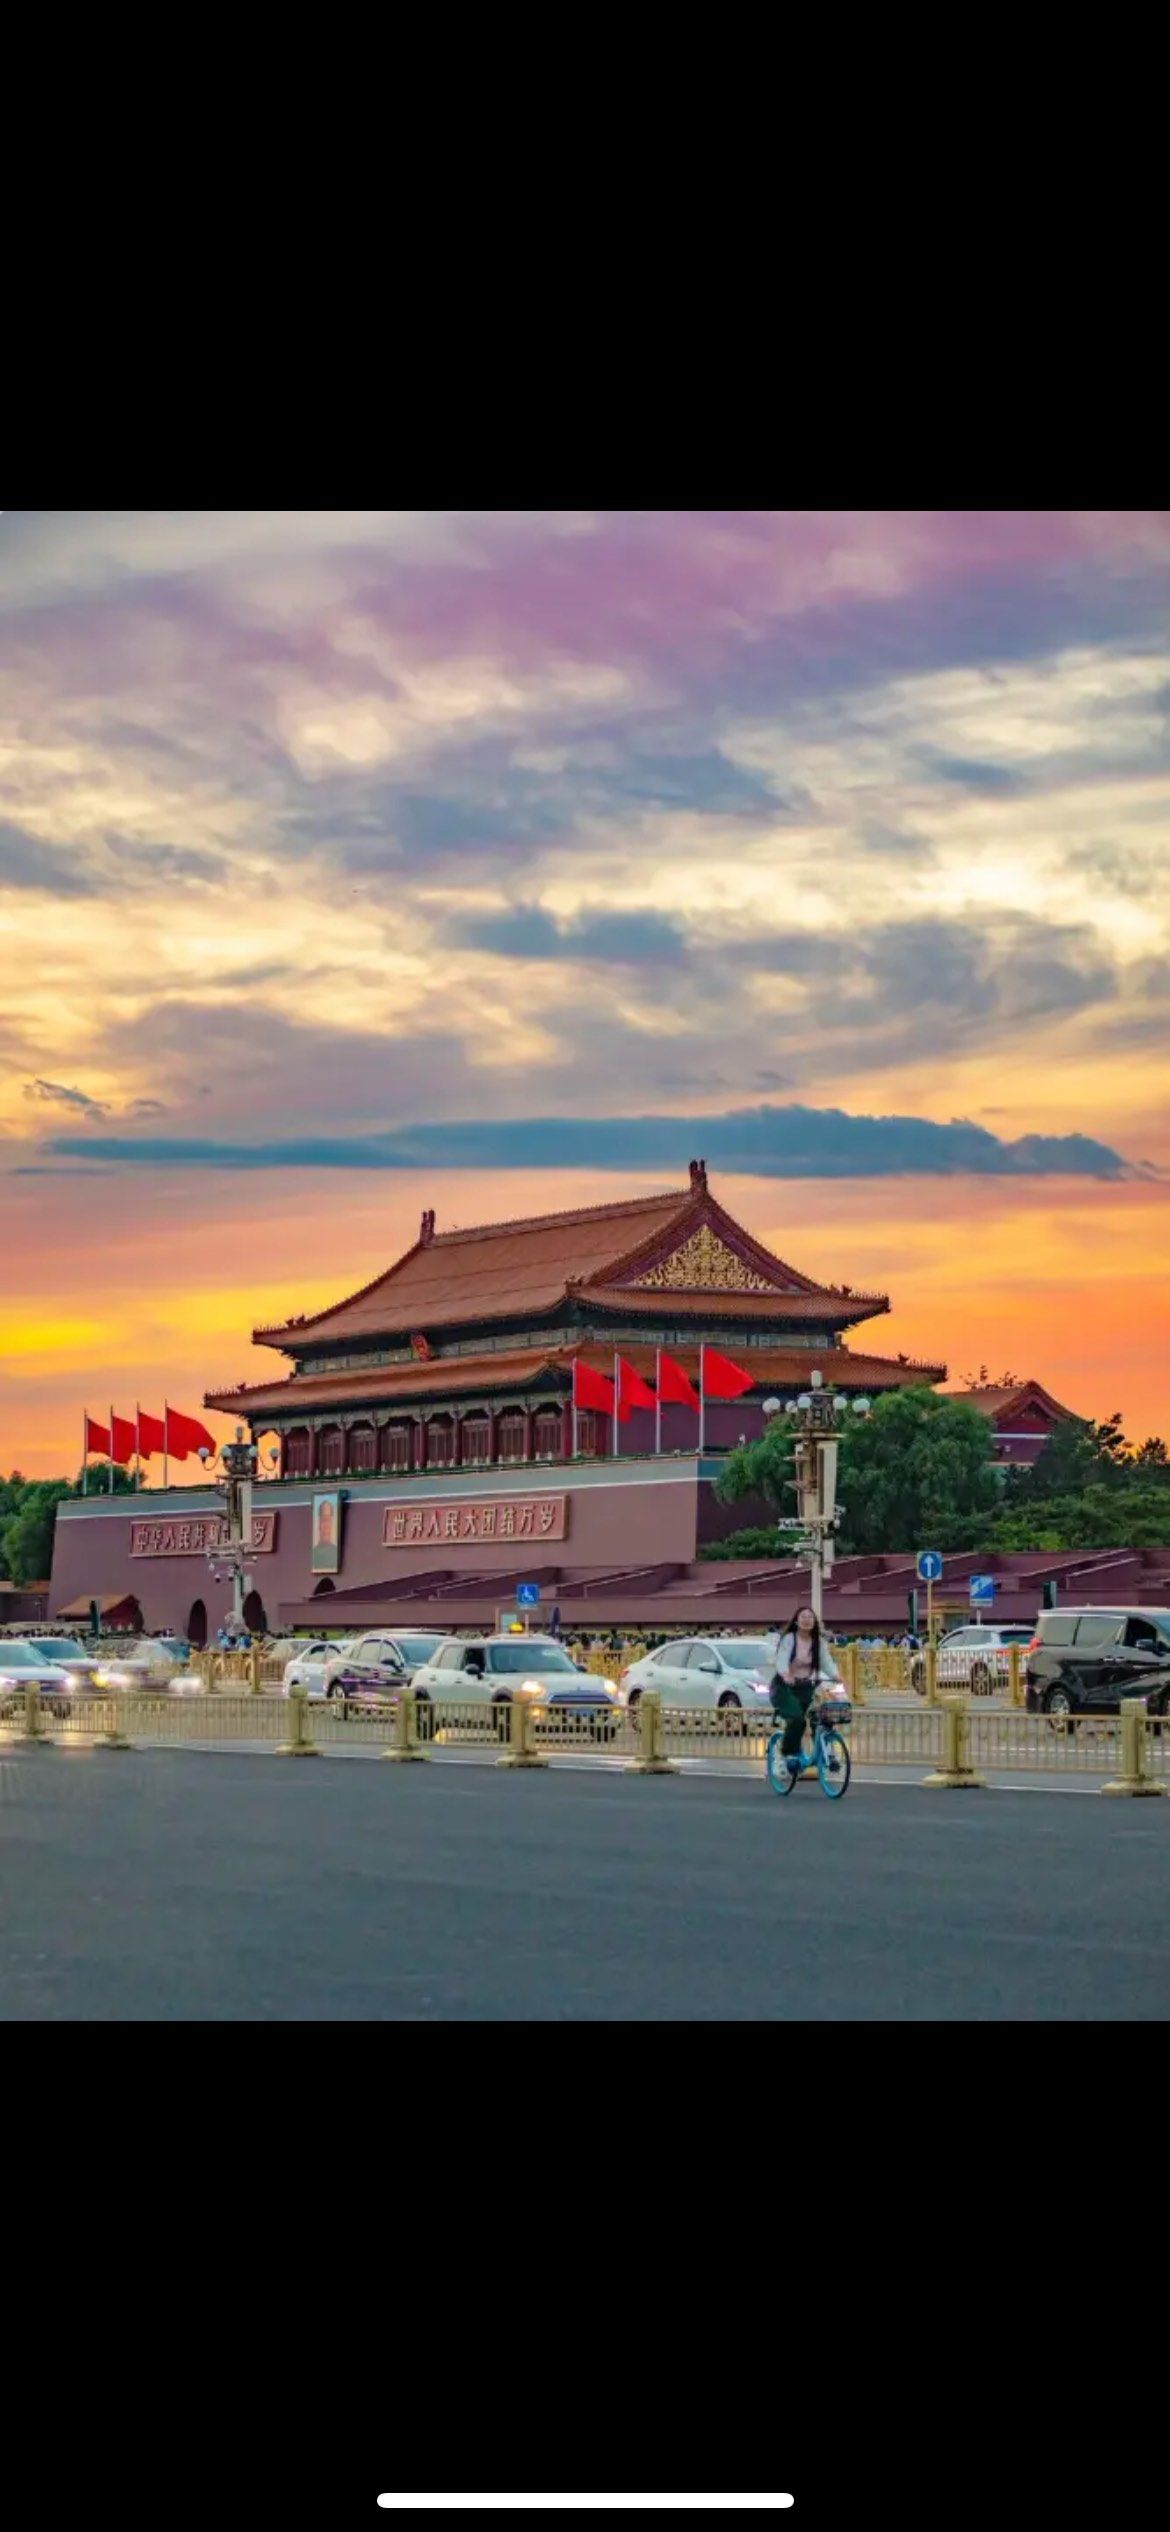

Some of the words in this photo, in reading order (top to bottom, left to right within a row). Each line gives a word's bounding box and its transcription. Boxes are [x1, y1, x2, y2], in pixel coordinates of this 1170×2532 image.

[392, 1503, 557, 1540] 世界人民大团结万岁
